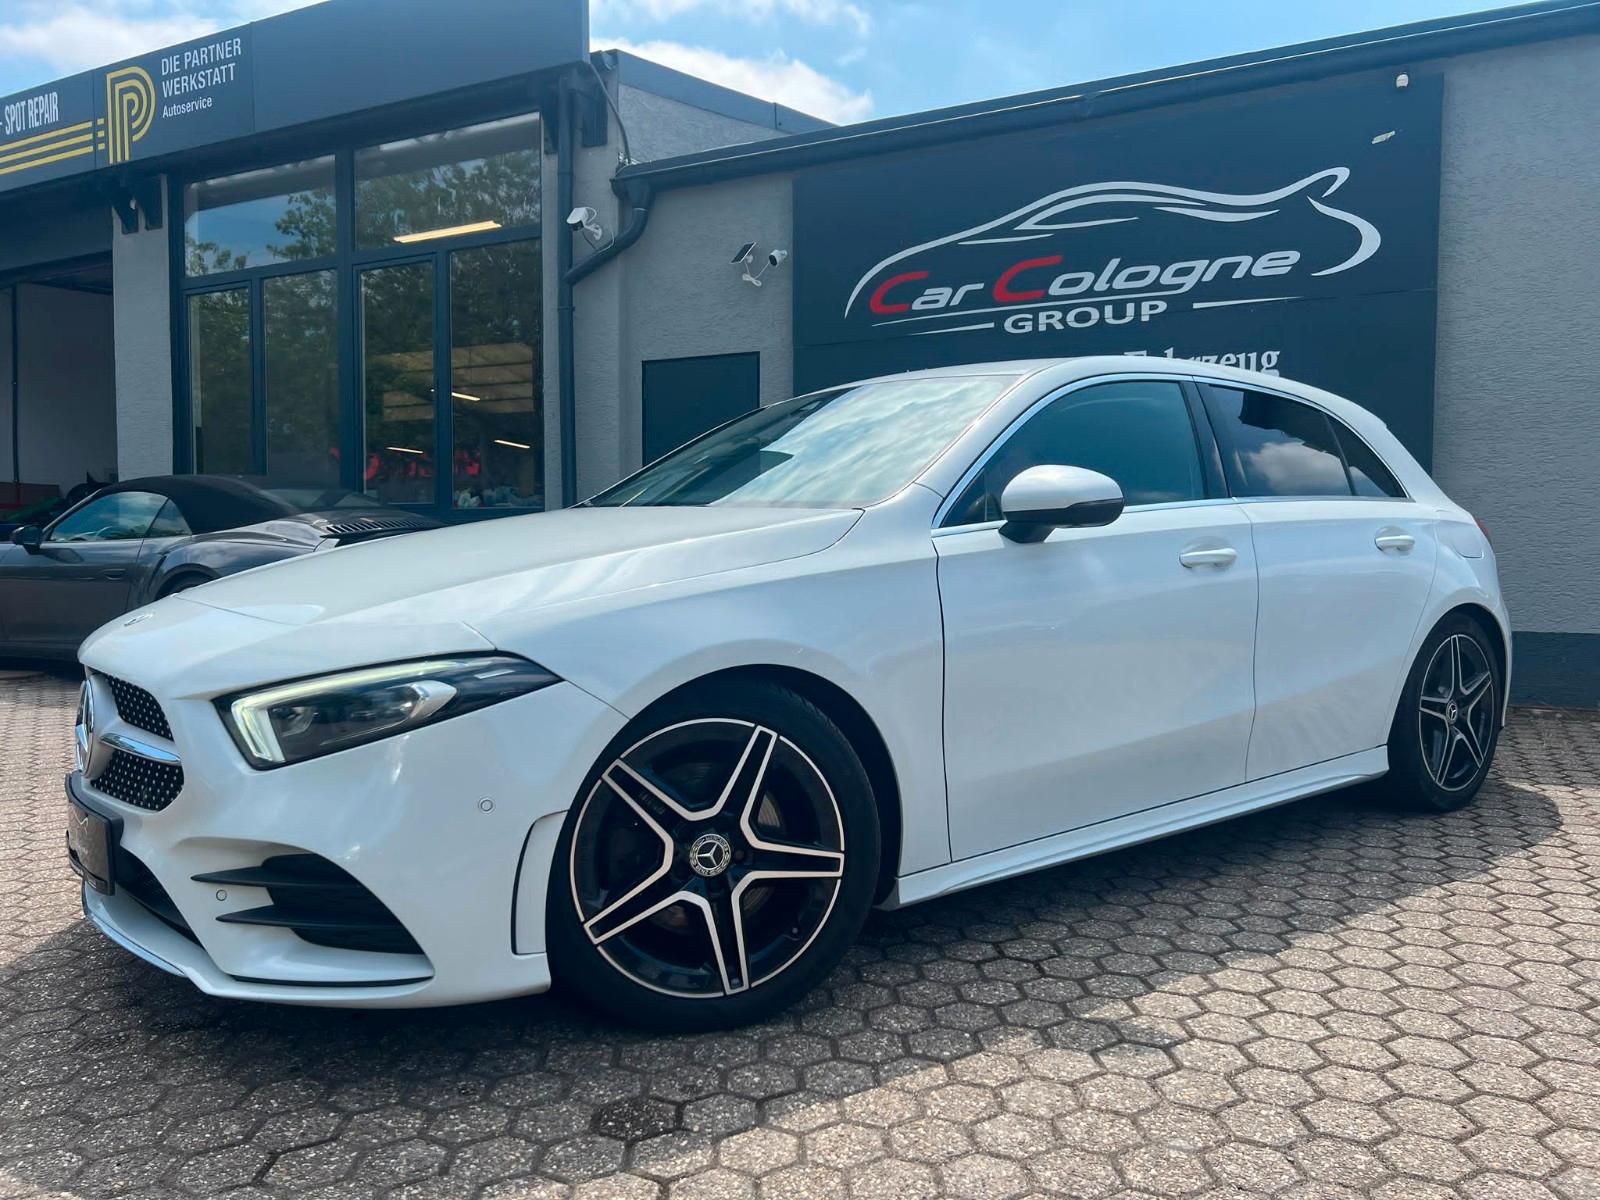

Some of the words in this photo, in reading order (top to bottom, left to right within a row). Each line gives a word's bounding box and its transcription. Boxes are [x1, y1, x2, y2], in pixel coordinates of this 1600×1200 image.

[161, 55, 181, 76] DIE
[184, 37, 241, 67] PARTNER
[162, 63, 236, 98] WERKSTATT
[4, 101, 27, 136] SPOT
[27, 91, 59, 128] REPAIR
[162, 96, 213, 118] Autoservice
[870, 271, 985, 314] Car
[993, 250, 1301, 303] Cologne
[1003, 300, 1168, 334] GROUP
